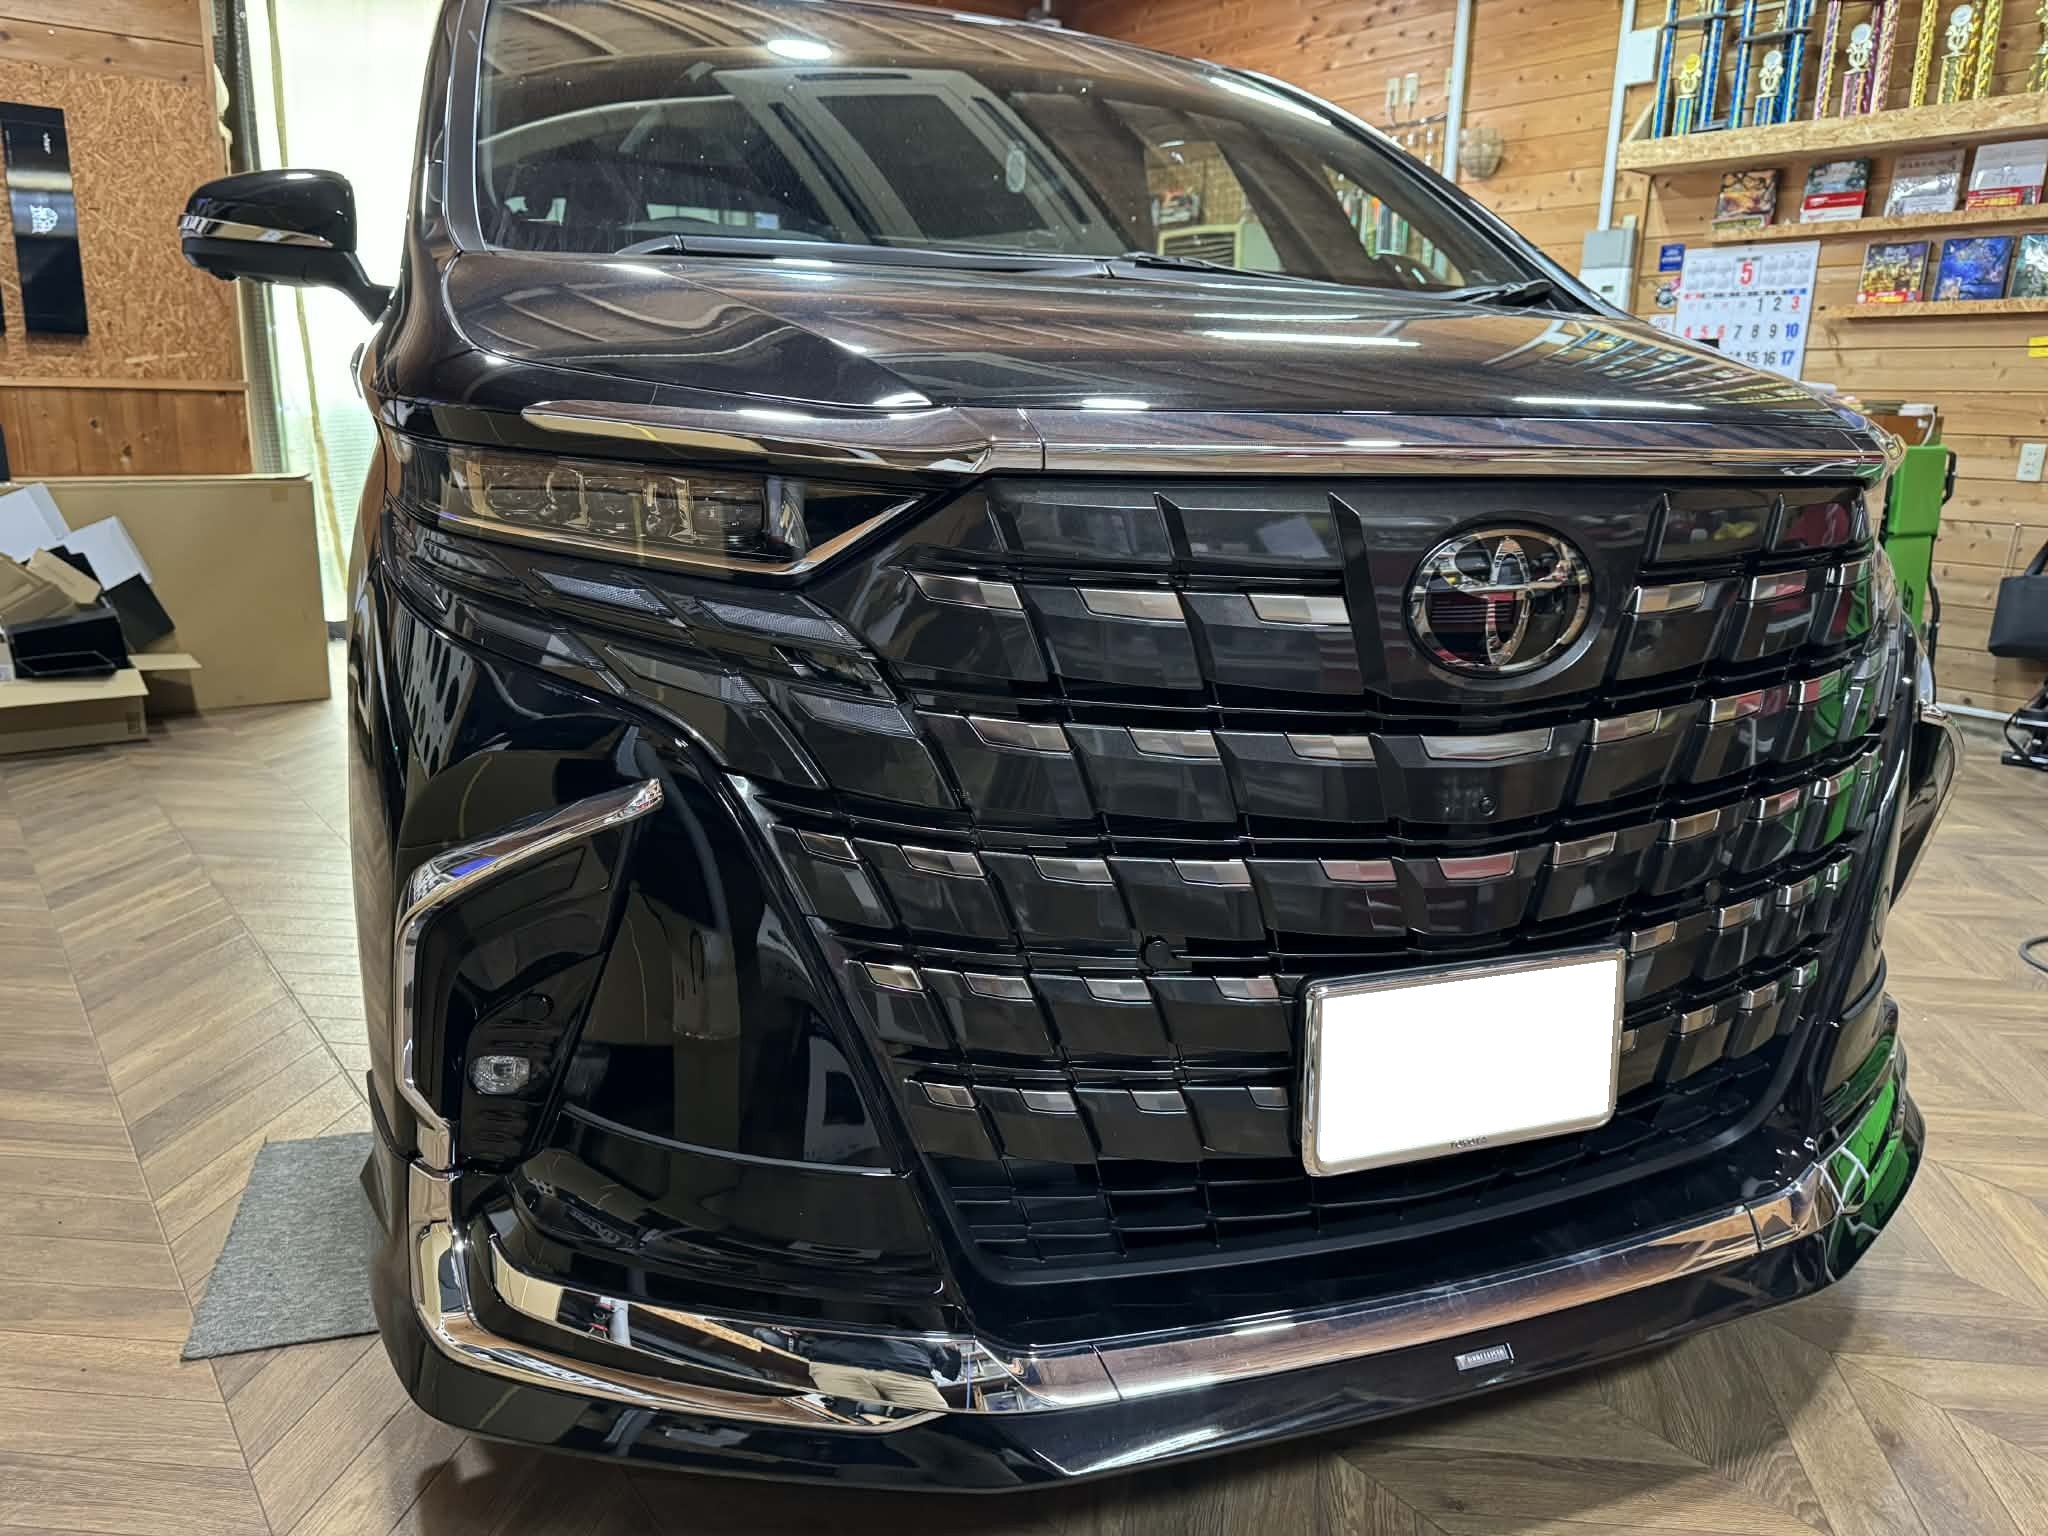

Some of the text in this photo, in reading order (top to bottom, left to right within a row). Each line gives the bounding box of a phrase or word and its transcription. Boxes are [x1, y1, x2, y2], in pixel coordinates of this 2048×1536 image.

[1740, 262, 1753, 285] 5
[1757, 297, 1763, 313] 1
[1773, 296, 1783, 312] 2
[1791, 295, 1800, 311] 3
[1734, 325, 1743, 339] 7
[1751, 324, 1760, 339] 8
[1769, 323, 1778, 339] 9
[1785, 322, 1800, 339] 10
[1746, 350, 1795, 366] 15 16 17
